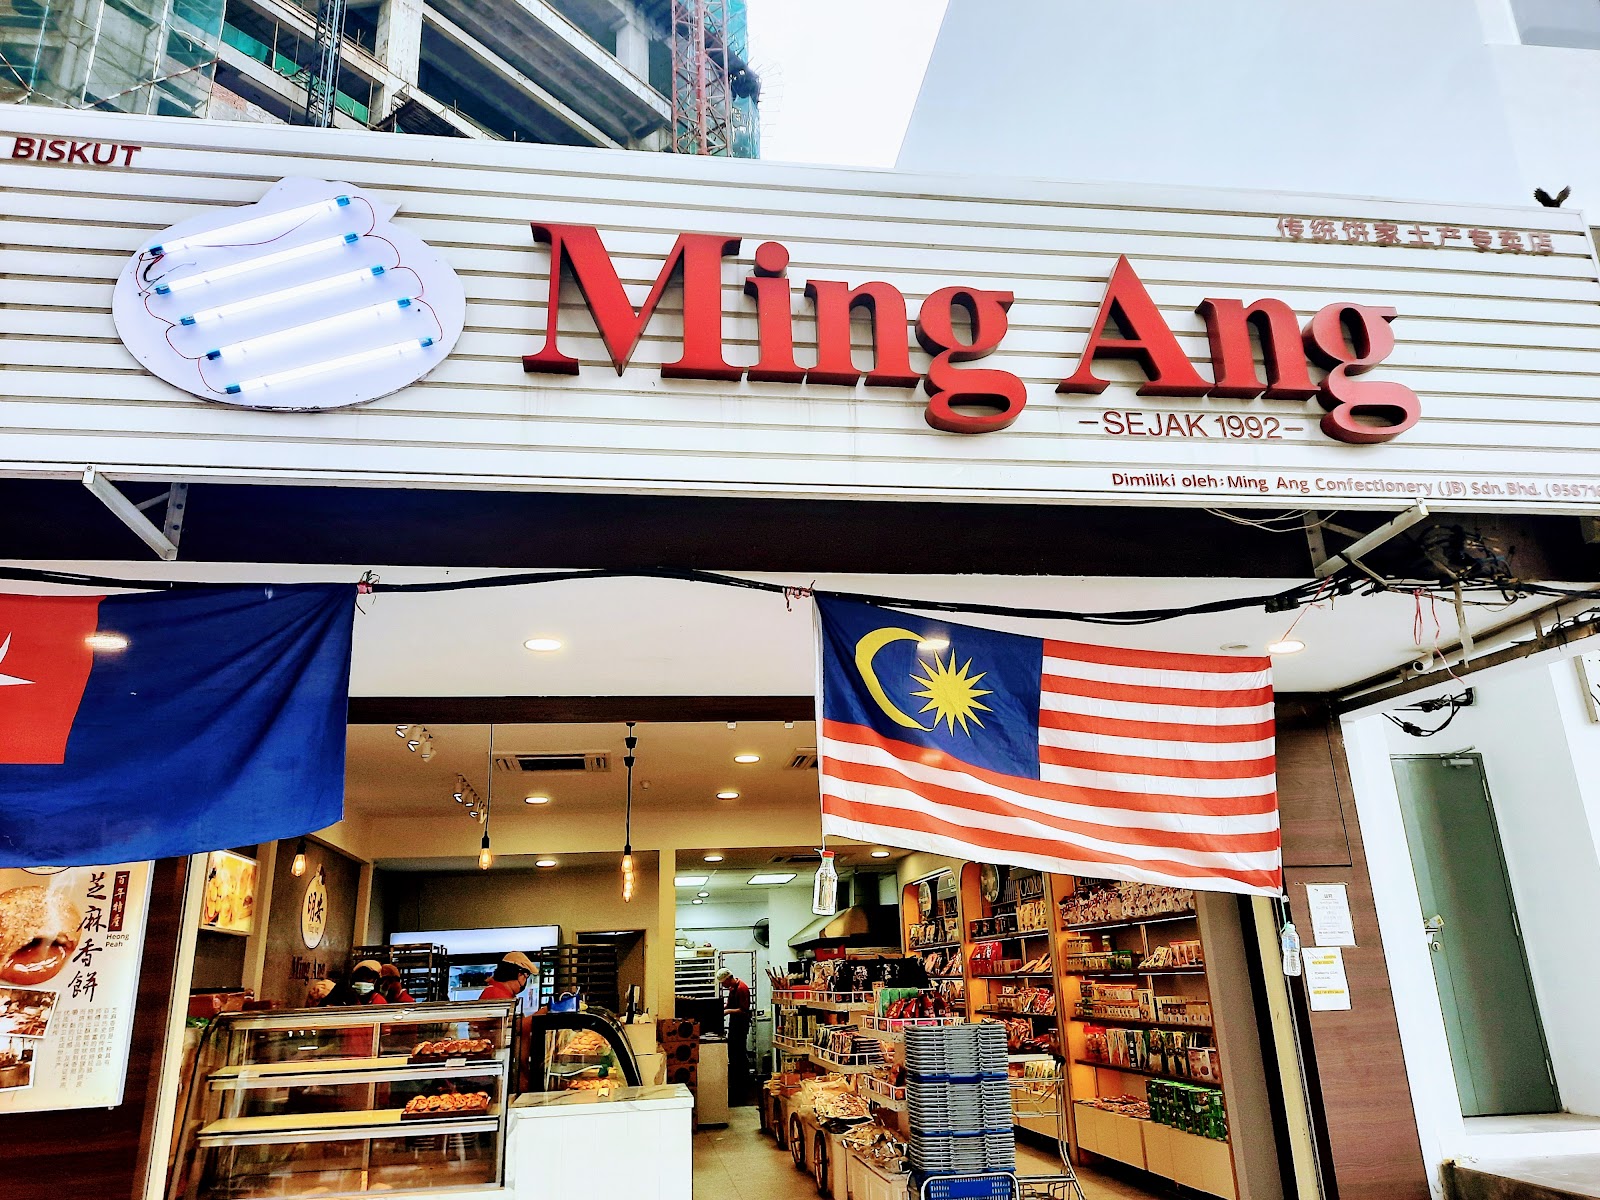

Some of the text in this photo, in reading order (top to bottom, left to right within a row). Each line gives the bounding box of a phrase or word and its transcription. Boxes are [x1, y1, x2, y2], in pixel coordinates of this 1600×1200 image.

[12, 137, 142, 167] BISKUT
[1276, 215, 1555, 255] 传统饼家土产专卖店
[522, 222, 1422, 444] Ming Ang
[1112, 472, 1177, 487] Dimiliki
[1227, 474, 1269, 493] Ming
[1276, 476, 1309, 494] Ang
[1315, 477, 1433, 496] Confectionery
[1438, 480, 1467, 497] (JB)
